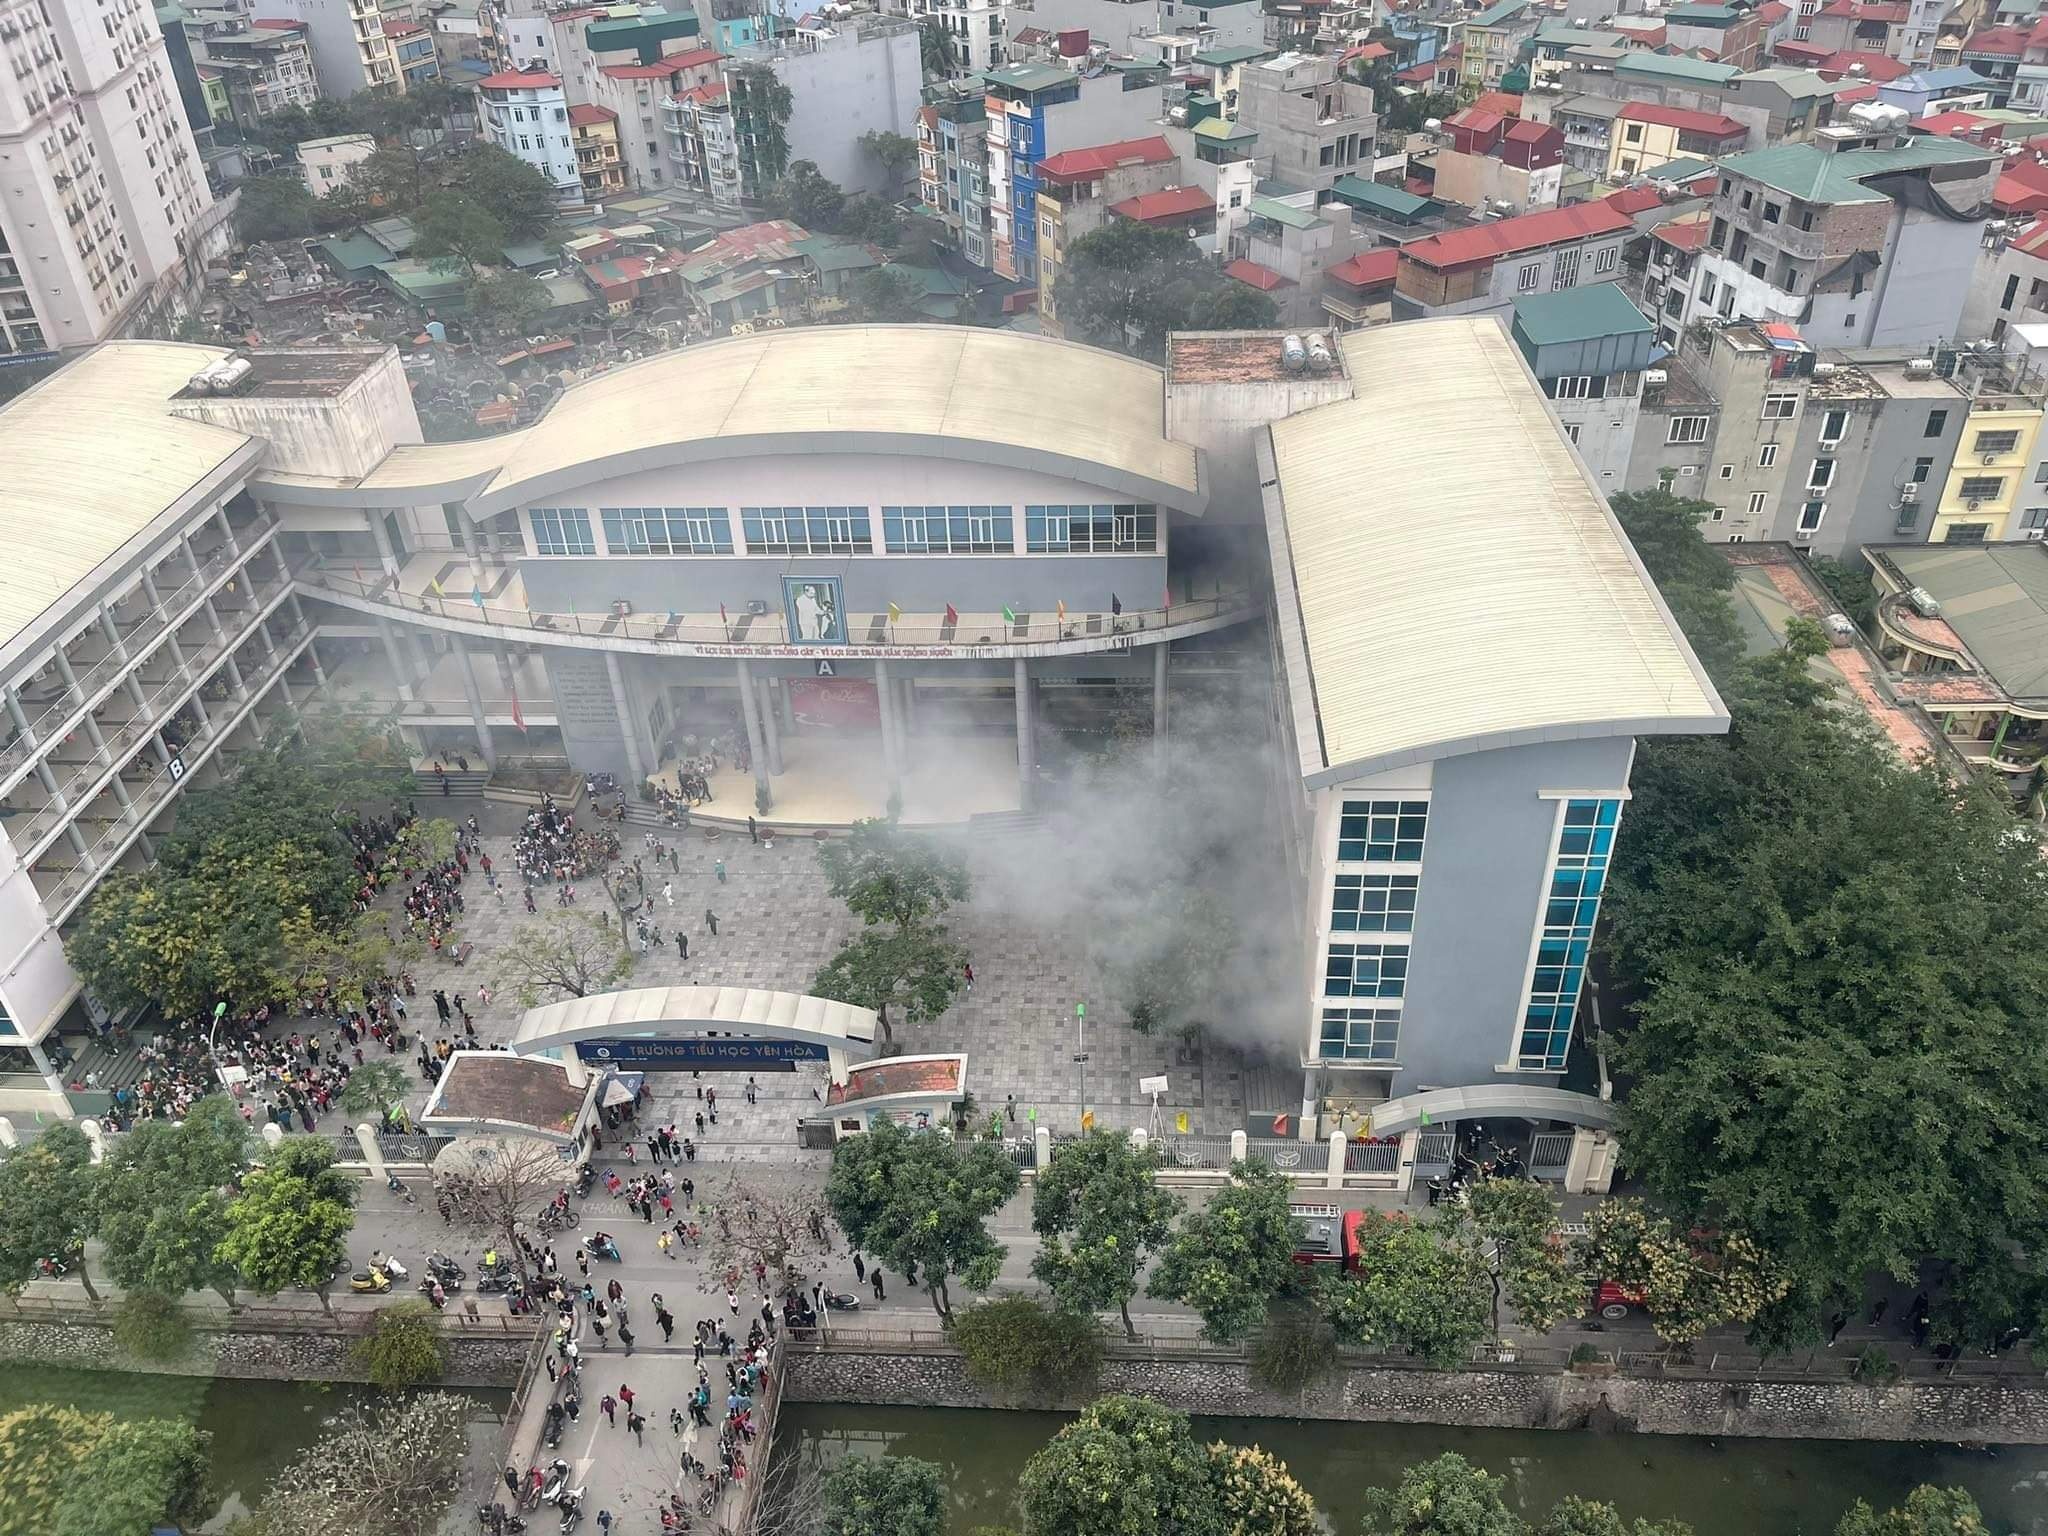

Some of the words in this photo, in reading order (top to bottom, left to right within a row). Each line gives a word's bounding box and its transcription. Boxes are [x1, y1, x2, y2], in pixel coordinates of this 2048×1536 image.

[818, 660, 834, 675] A
[170, 759, 184, 780] B
[719, 1046, 751, 1058] HỌC
[754, 1045, 780, 1056] YÊN
[784, 1044, 815, 1057] HÒA
